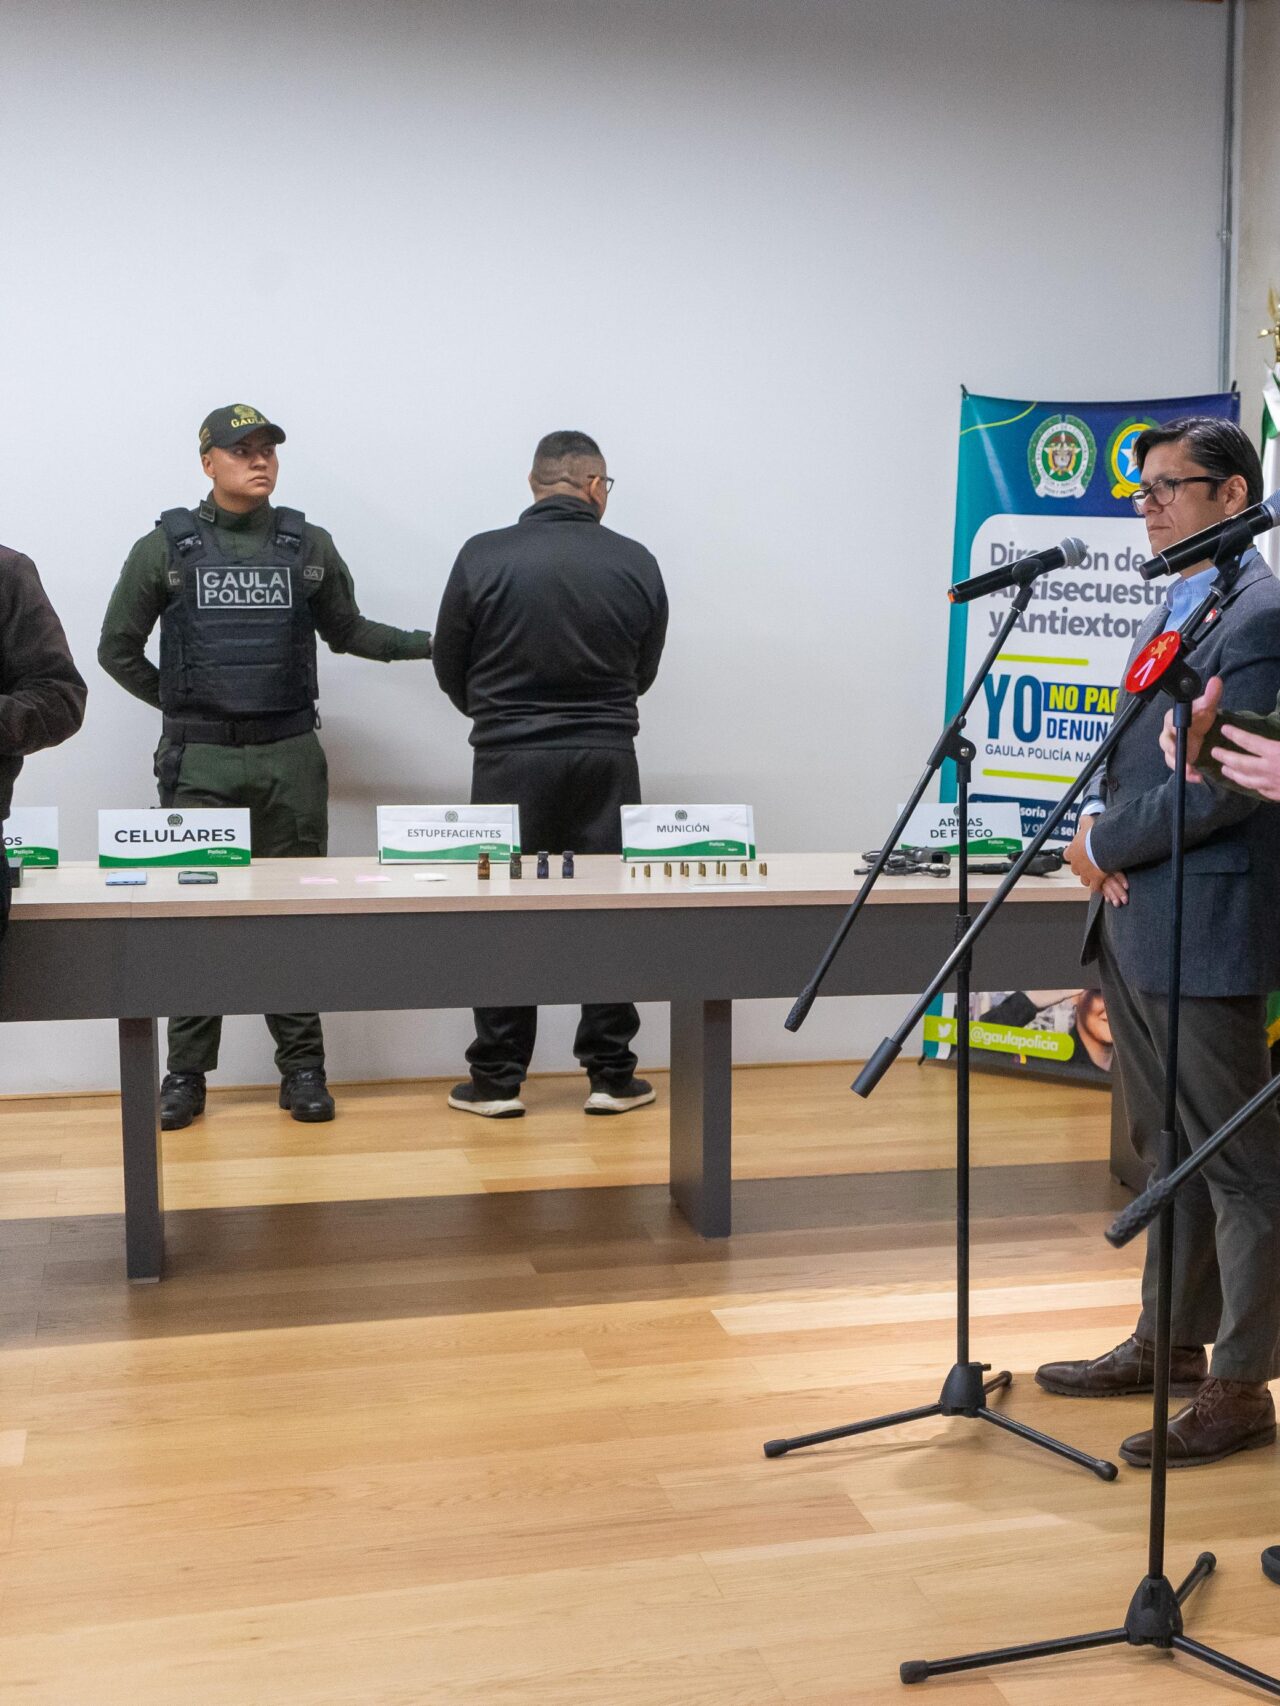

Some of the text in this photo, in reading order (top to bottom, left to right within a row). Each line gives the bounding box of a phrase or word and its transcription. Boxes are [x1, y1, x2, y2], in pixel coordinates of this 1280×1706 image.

[1114, 547, 1145, 572] de
[203, 571, 285, 588] GAULA
[204, 589, 285, 604] POLICIA
[988, 610, 1004, 638] y
[1049, 685, 1080, 711] NO
[983, 673, 1043, 743] YO
[985, 743, 1025, 758] GAULA
[1027, 746, 1071, 762] POLICÍA
[656, 823, 710, 833] MUNICIÓN
[938, 817, 983, 827] ARAS
[114, 828, 237, 843] CELULARES
[407, 828, 502, 839] ESTUPEFACIENTES
[930, 829, 993, 839] DE FEGO
